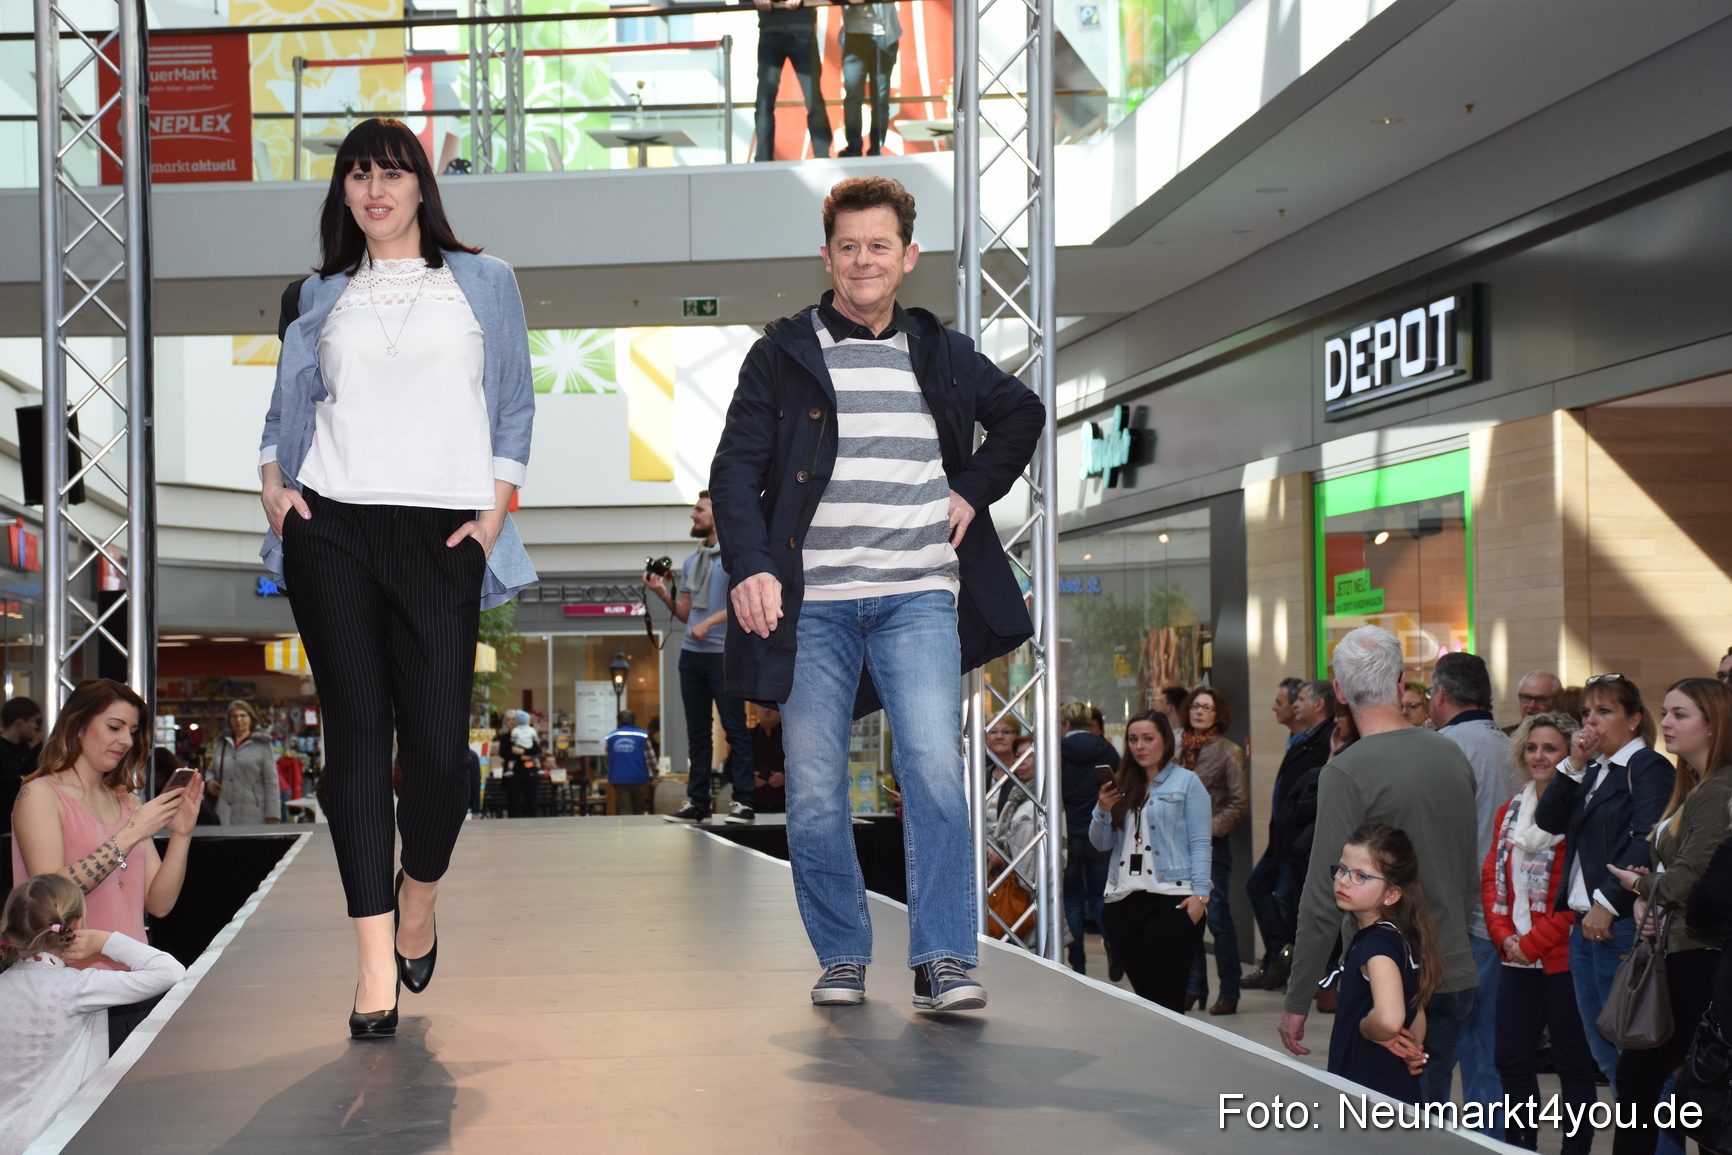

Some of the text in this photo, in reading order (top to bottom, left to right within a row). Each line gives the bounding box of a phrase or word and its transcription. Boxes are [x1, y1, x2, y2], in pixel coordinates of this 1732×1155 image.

[150, 67, 217, 82] uerMarkt
[117, 114, 231, 134] NEPLEX
[1325, 296, 1455, 402] DEPOT
